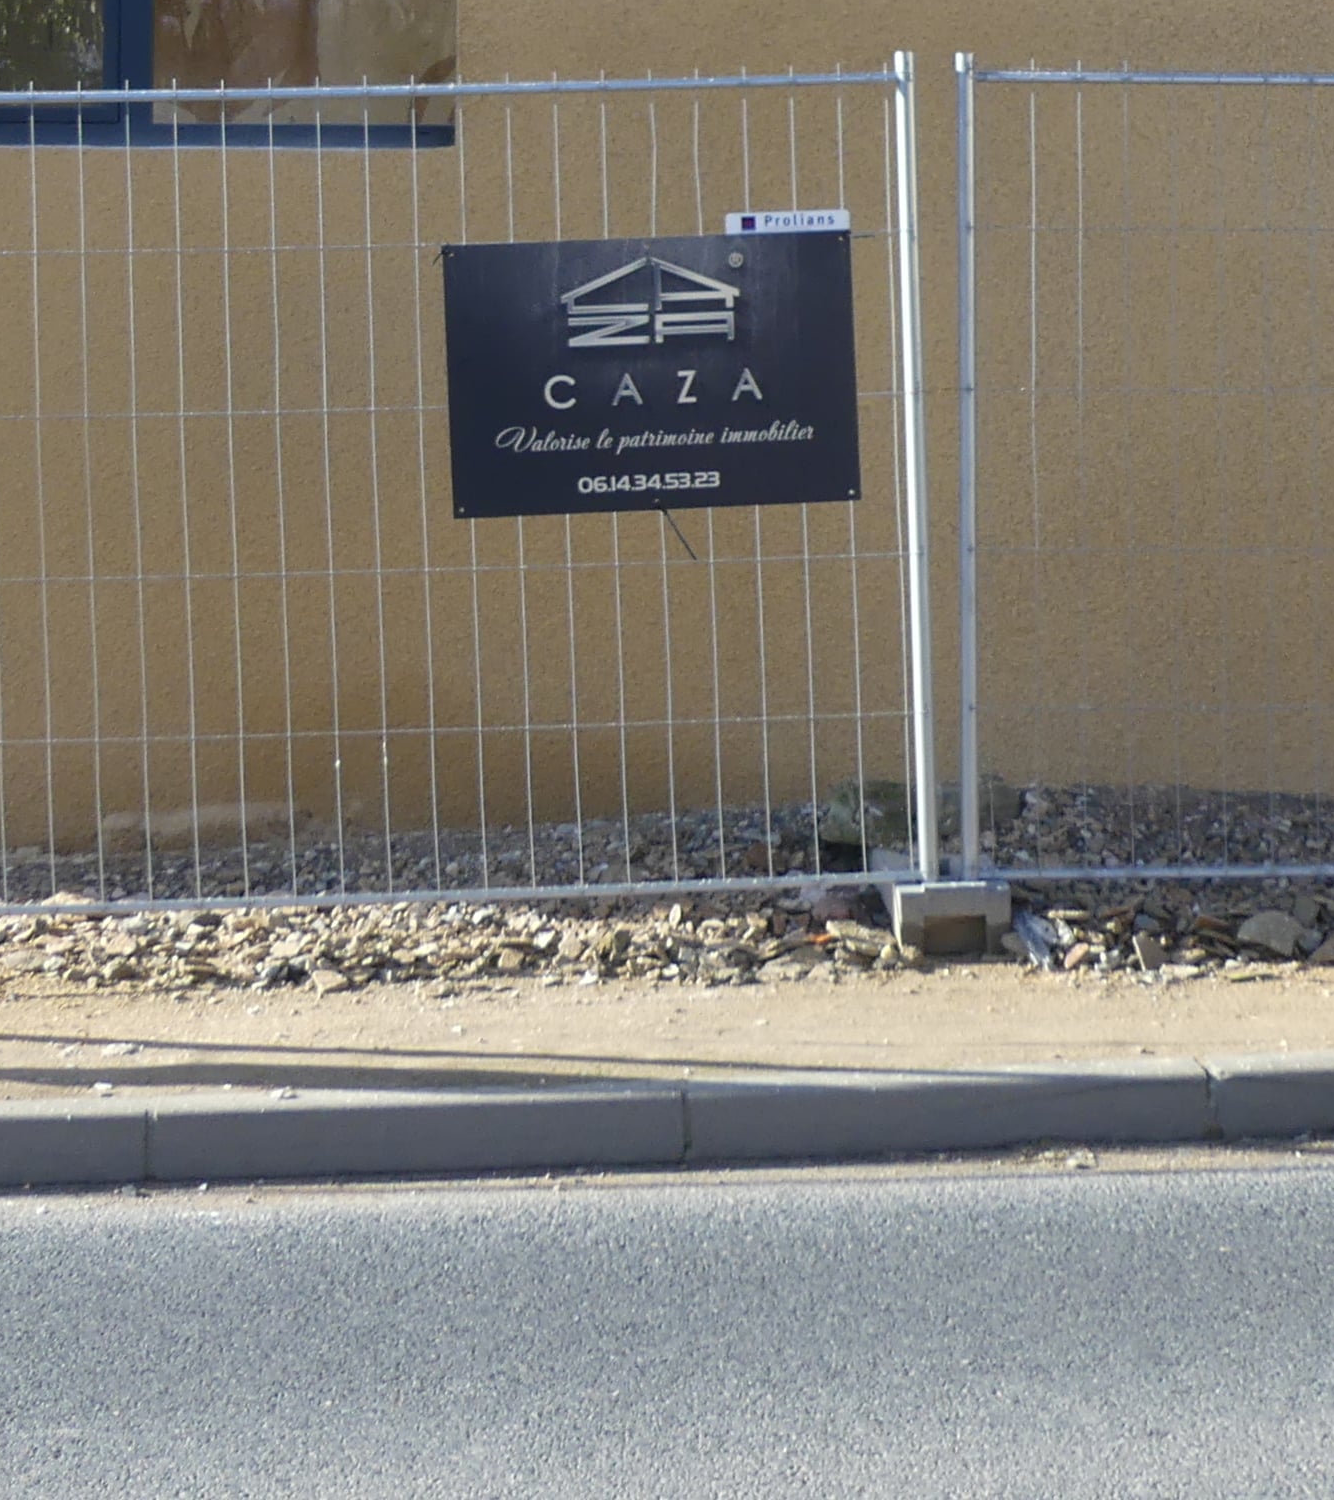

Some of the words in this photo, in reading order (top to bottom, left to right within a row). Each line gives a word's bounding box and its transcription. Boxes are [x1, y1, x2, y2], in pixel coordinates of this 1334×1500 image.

[764, 214, 835, 227] Prolians
[544, 367, 763, 410] CAZA
[495, 425, 590, 453] Valorise
[596, 427, 613, 450] le
[616, 426, 715, 456] patrimoine
[720, 419, 815, 445] immobilier
[577, 470, 721, 494] 06.14.34.53.23
